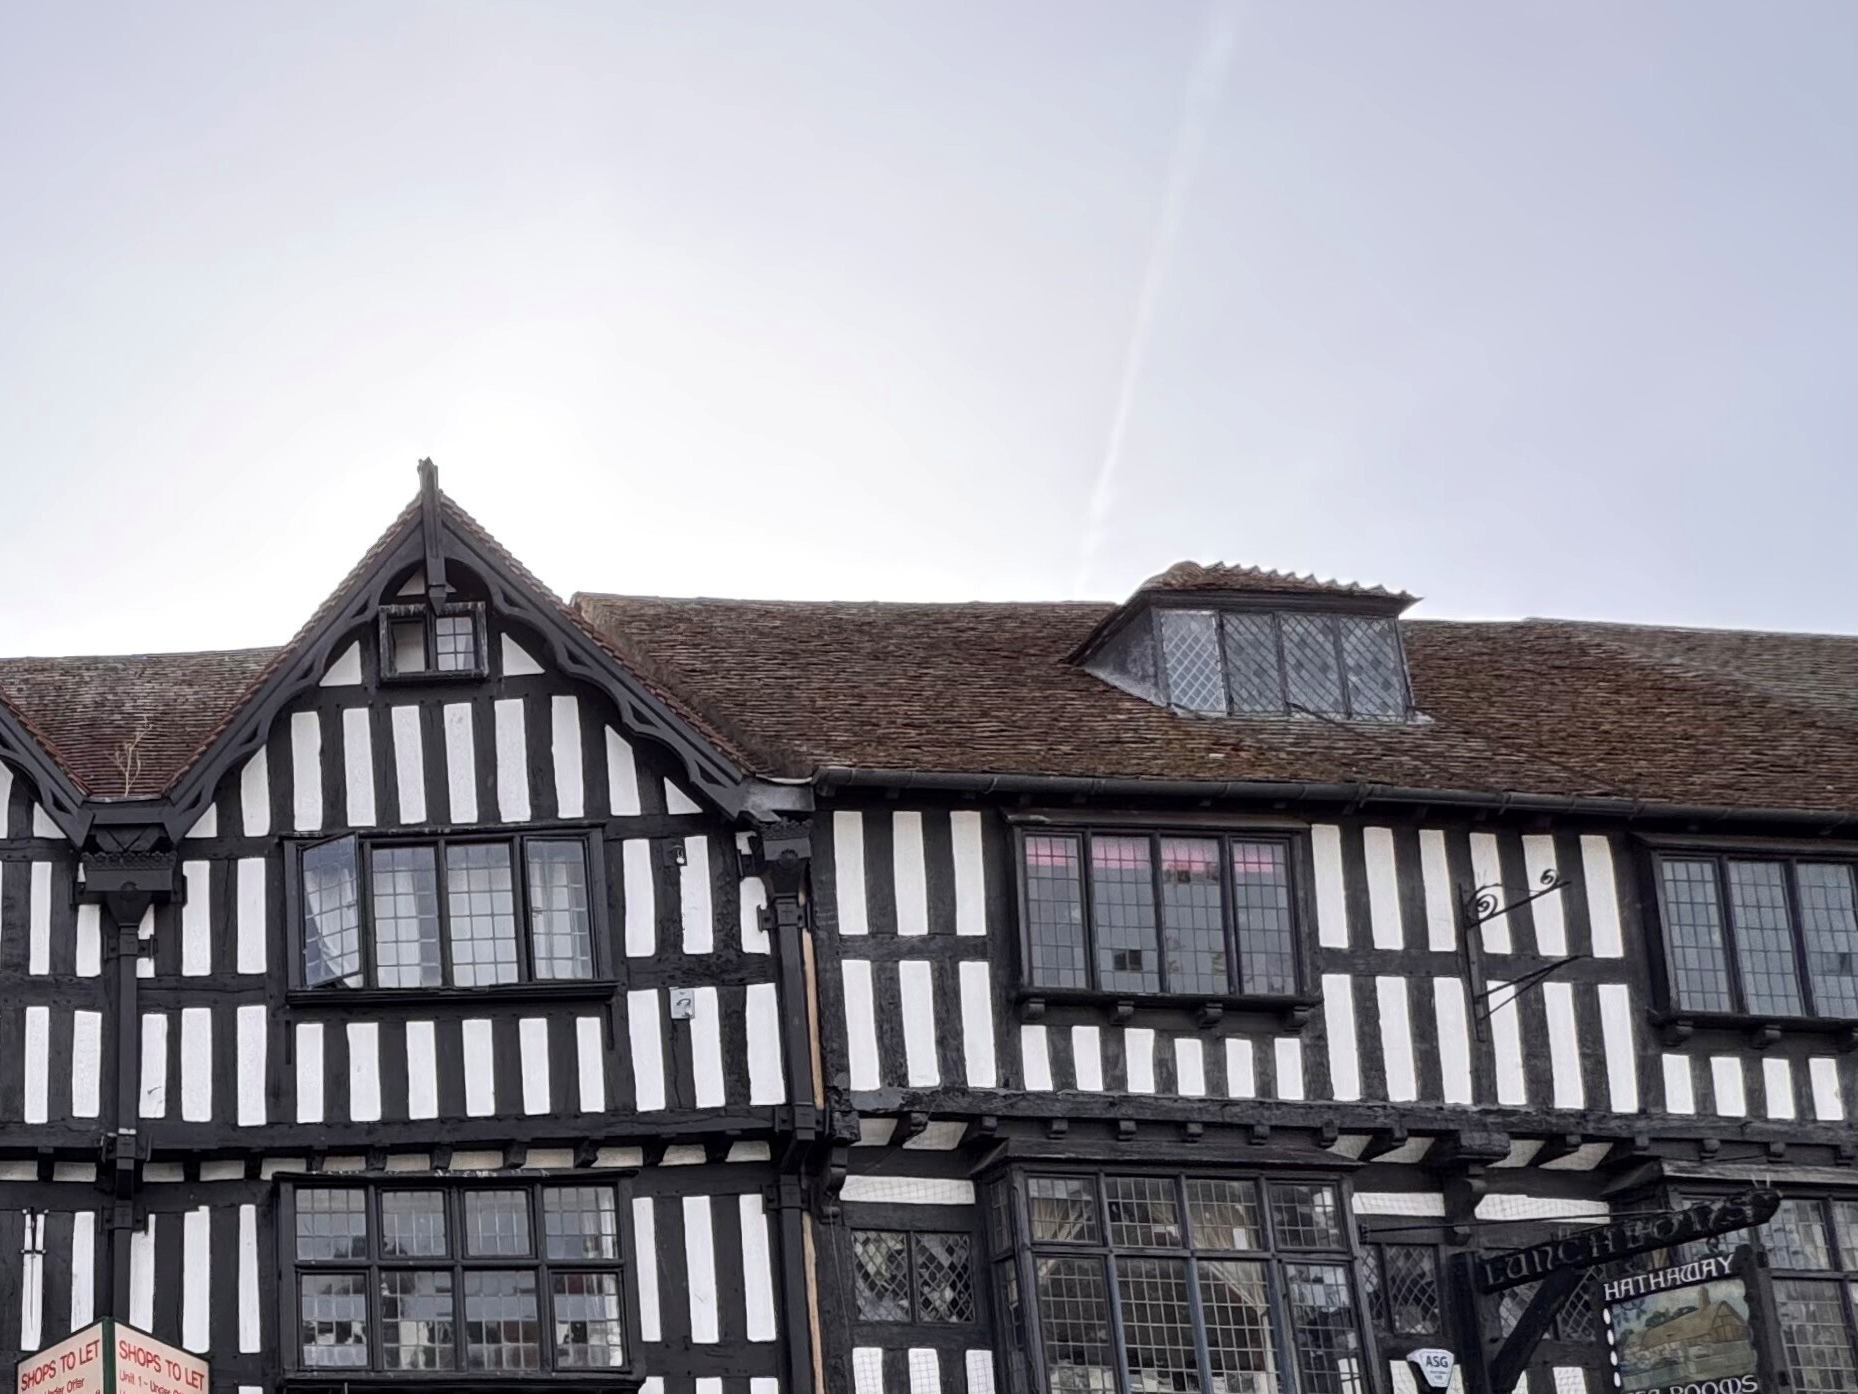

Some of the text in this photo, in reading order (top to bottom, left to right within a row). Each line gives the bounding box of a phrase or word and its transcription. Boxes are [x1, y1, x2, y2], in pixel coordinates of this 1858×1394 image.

[1603, 1254, 1735, 1301] HATHAWAY
[21, 1339, 100, 1392] SHOPS TO LET
[119, 1340, 205, 1391] SHOPS TO LET
[119, 1369, 135, 1385] Unit
[1426, 1355, 1449, 1368] ASG
